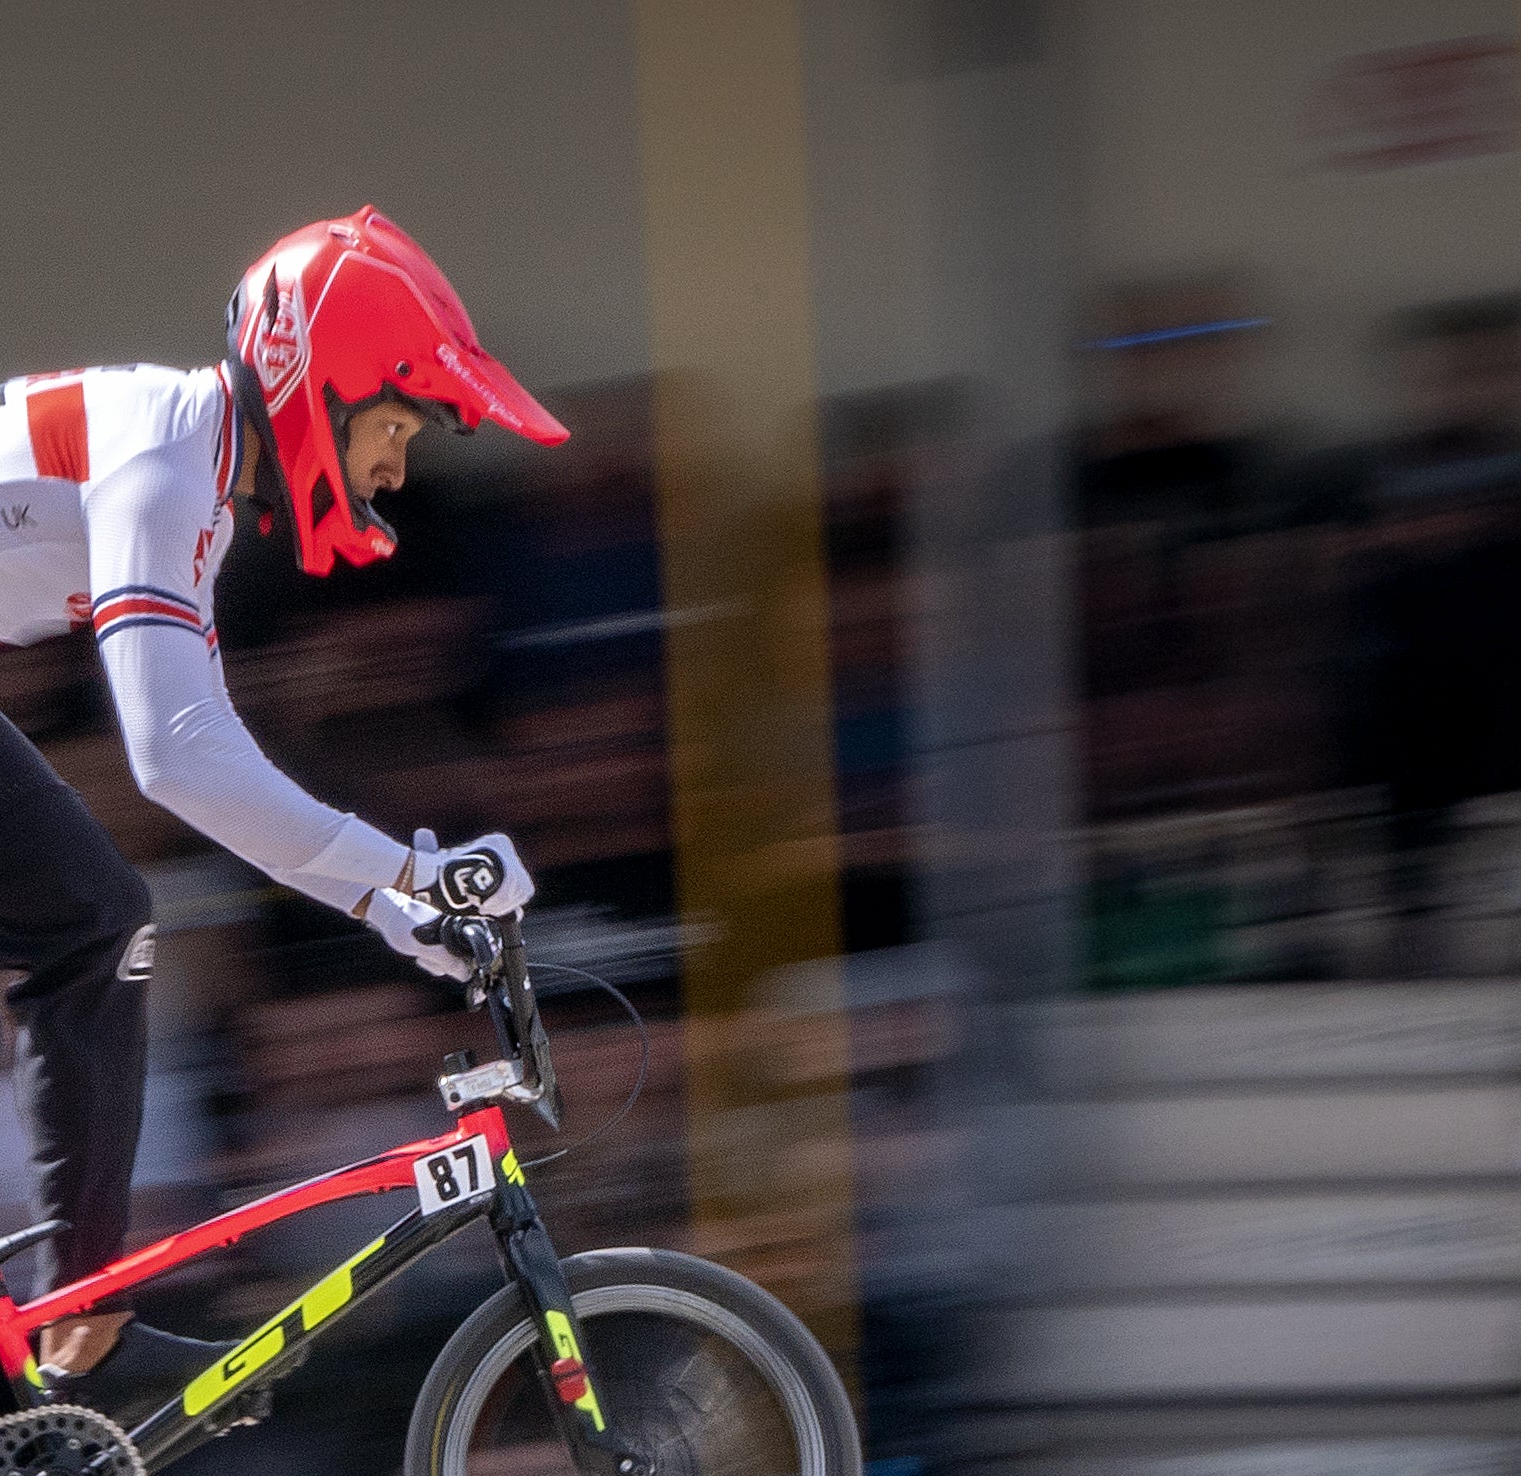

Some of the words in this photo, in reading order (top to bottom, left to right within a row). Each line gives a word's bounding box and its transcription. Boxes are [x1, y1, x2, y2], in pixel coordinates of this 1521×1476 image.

[0, 504, 38, 530] UK
[427, 1144, 479, 1202] 87
[183, 1236, 386, 1416] GT
